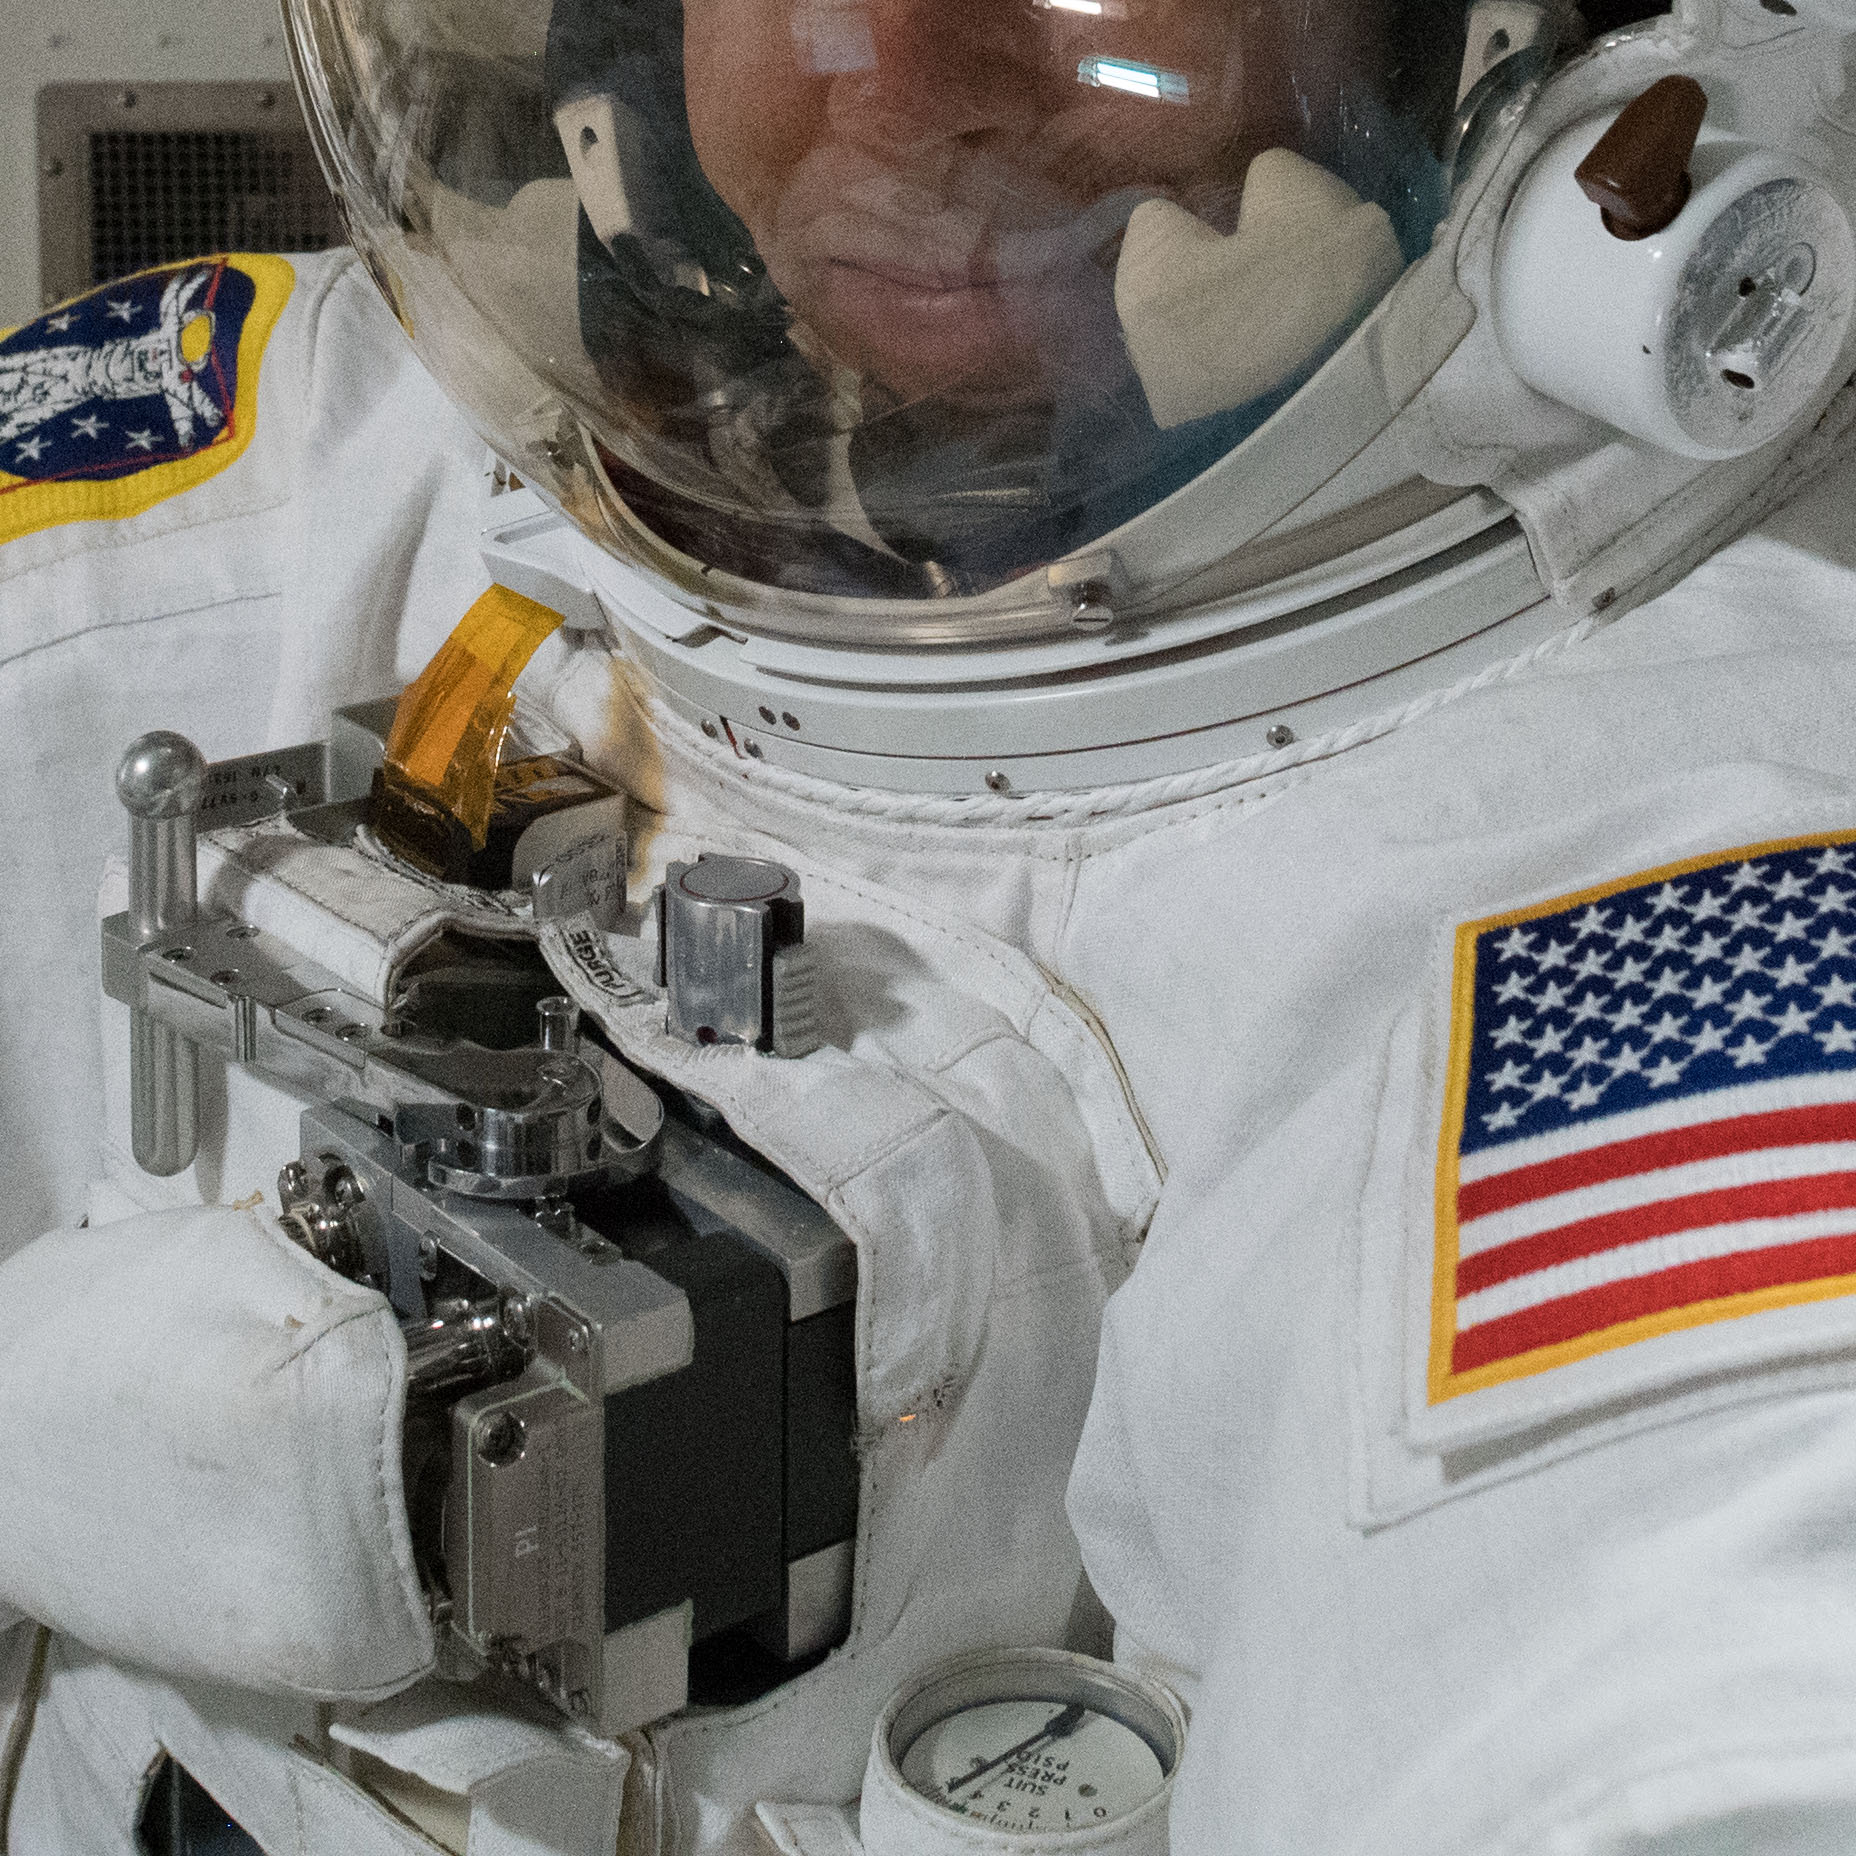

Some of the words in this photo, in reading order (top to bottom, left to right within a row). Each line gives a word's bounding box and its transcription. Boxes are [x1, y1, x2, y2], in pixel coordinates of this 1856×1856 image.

[1006, 1761, 1067, 1786] PRESS
[1003, 1776, 1048, 1796] SUIT
[996, 1800, 1011, 1812] 3
[1028, 1806, 1041, 1819] 2
[1093, 1806, 1107, 1819] 0
